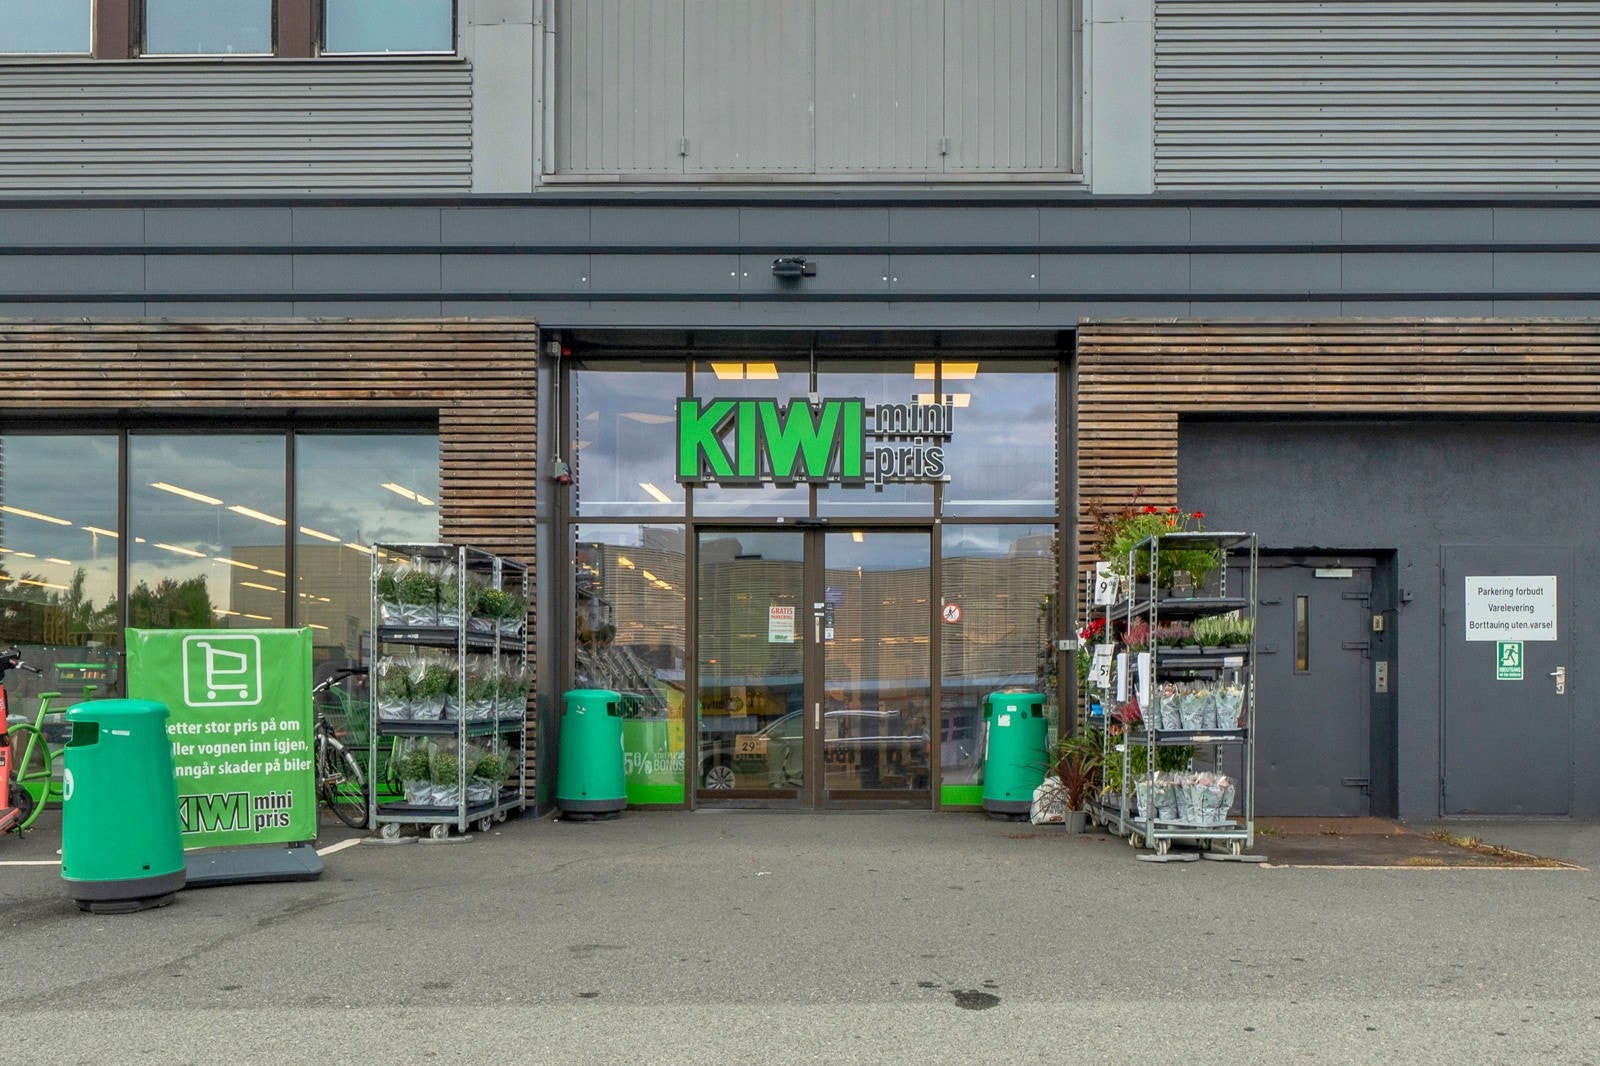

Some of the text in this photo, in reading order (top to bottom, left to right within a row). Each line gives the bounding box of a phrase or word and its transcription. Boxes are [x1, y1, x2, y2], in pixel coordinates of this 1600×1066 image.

[875, 394, 953, 433] mini
[676, 397, 865, 483] KIWI
[874, 437, 945, 485] pris
[1477, 587, 1544, 598] Parkering forbudt
[771, 607, 793, 615] GRATIS
[1488, 603, 1535, 614] Varelevering
[1469, 620, 1509, 631] Borttauing
[166, 717, 300, 735] etter stor pris på om
[173, 738, 308, 757] ller vognen inn igjen,
[175, 758, 312, 779] nngår skader på biler
[624, 752, 652, 775] 5%
[654, 760, 685, 772] BONUS
[254, 790, 292, 810] mini
[254, 809, 290, 832] pris
